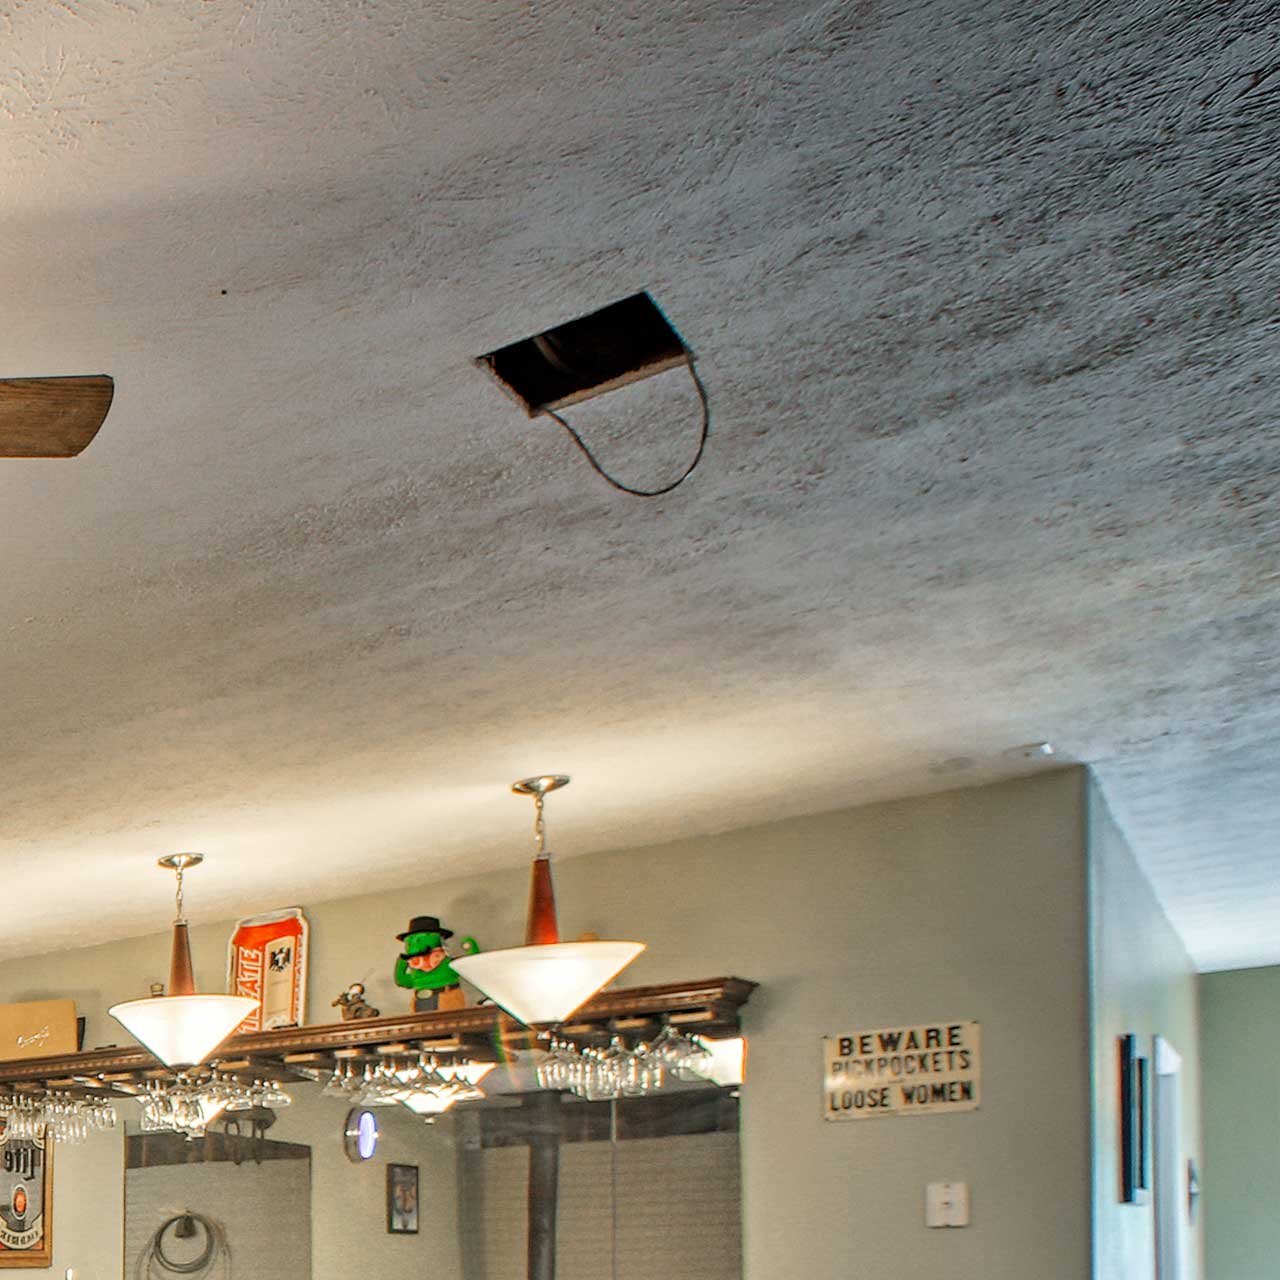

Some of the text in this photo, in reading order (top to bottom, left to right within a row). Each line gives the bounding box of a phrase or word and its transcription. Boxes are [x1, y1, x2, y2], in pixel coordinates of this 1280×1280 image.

[839, 1025, 963, 1057] BEWARE
[831, 1049, 972, 1078] PICKPOCKETS
[829, 1080, 974, 1111] LOOSE WOMEN
